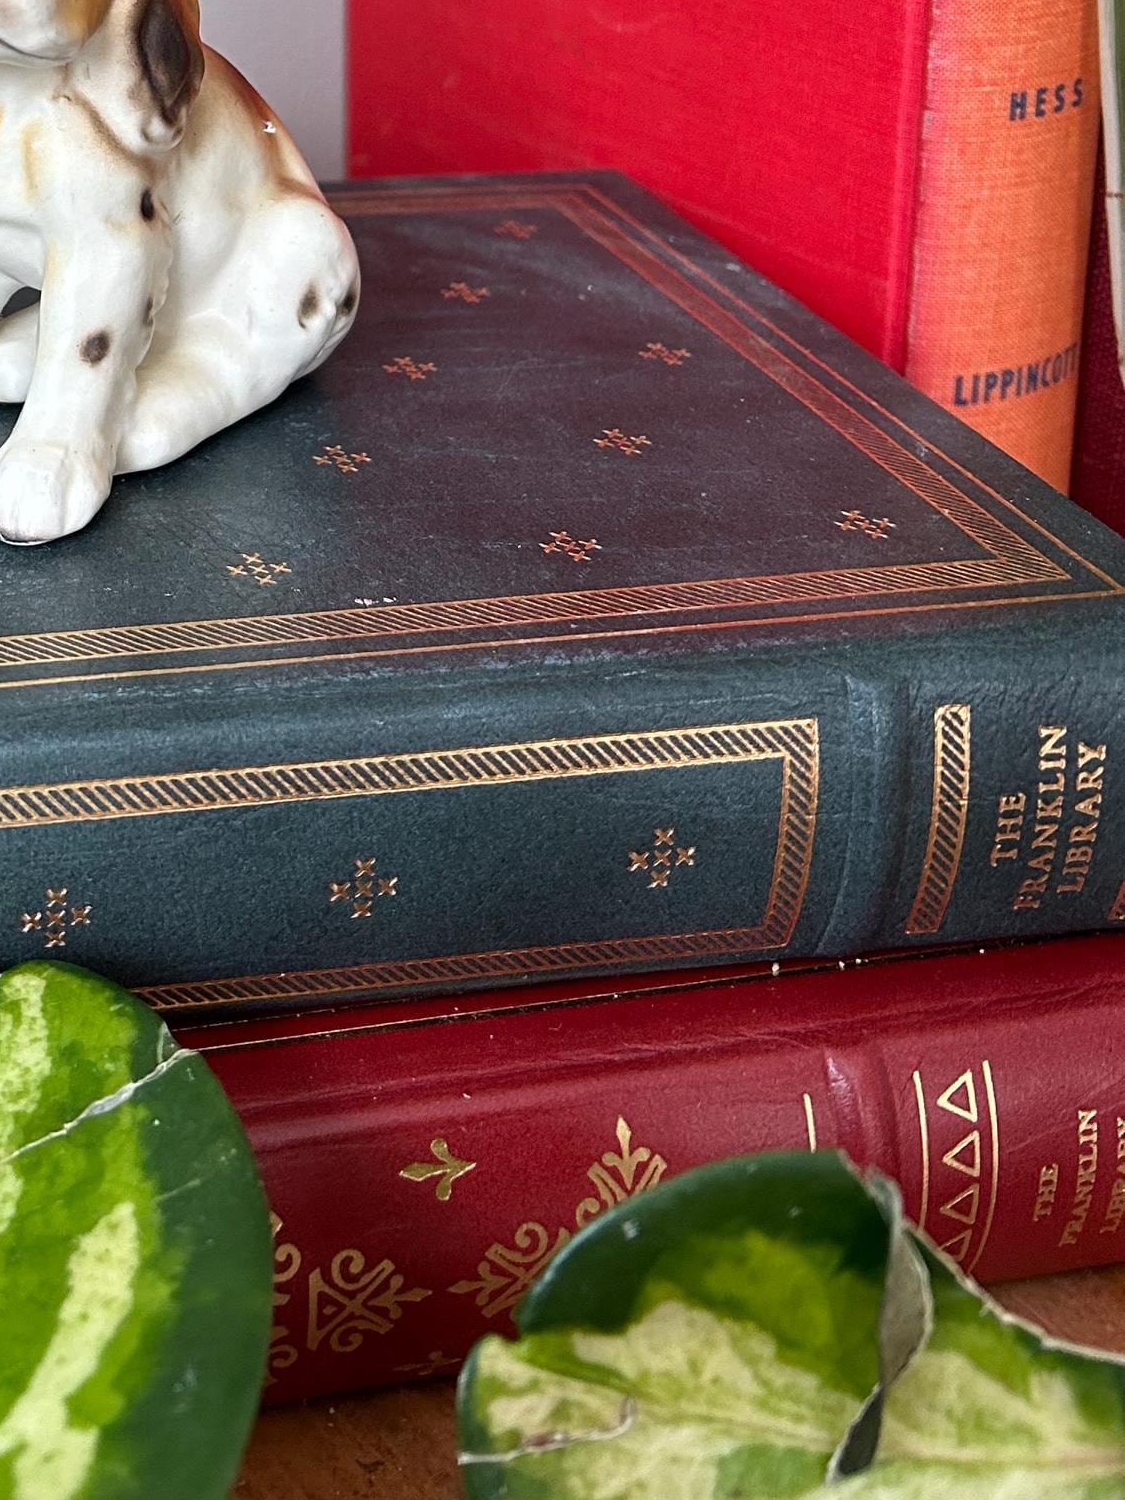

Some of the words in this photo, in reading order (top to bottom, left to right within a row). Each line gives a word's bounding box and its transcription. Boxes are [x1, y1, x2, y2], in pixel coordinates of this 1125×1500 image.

[1009, 78, 1084, 122] HESS
[990, 792, 1025, 868] THE
[1013, 724, 1068, 911] FRANKLIN
[1057, 741, 1107, 893] LIBRARY
[1033, 1163, 1059, 1222] THE
[1059, 1109, 1098, 1247] FRANKLIN
